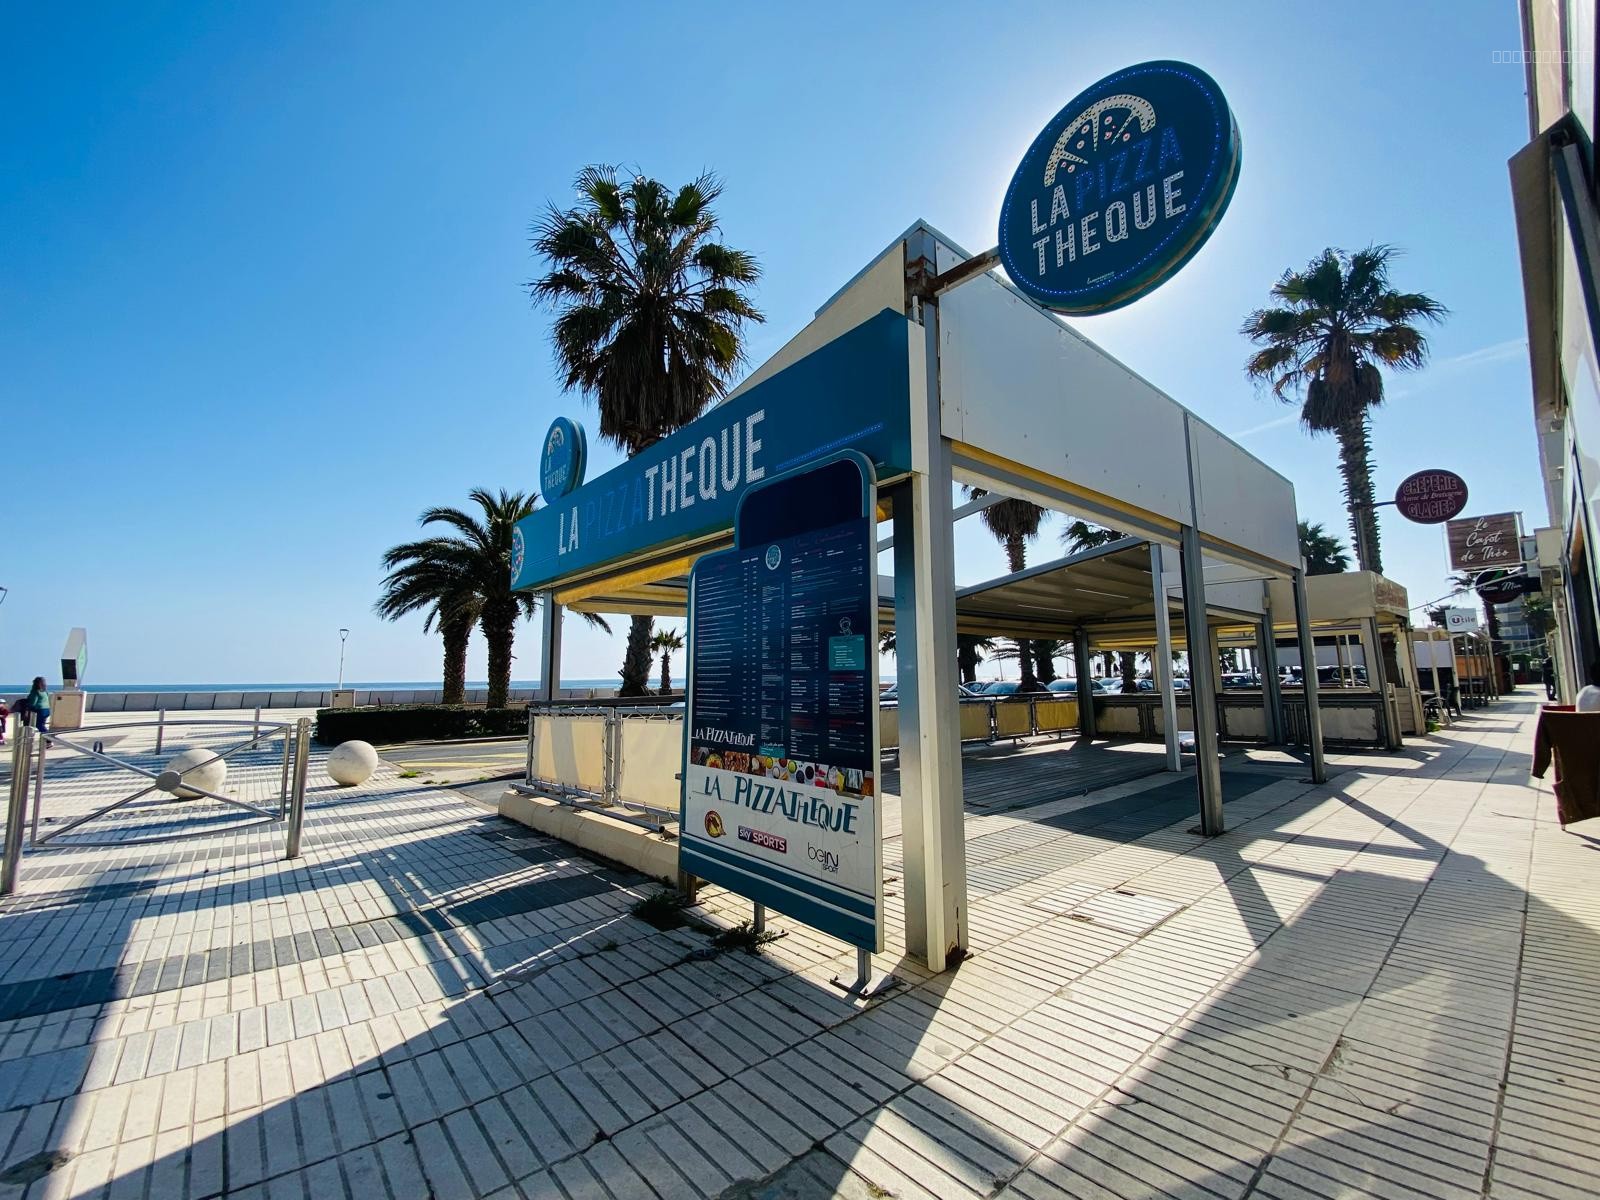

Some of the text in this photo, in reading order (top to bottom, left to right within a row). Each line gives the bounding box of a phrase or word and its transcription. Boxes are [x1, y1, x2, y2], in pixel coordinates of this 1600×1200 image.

[1031, 127, 1184, 235] LA PIZZA
[1032, 170, 1187, 276] THEQUE
[558, 506, 579, 556] LA
[644, 408, 766, 522] THEQUE
[1474, 517, 1488, 531] Le
[1461, 550, 1475, 562] de
[704, 775, 859, 834] LA PIZZATHEQUE
[739, 829, 786, 851] sky SPORTS
